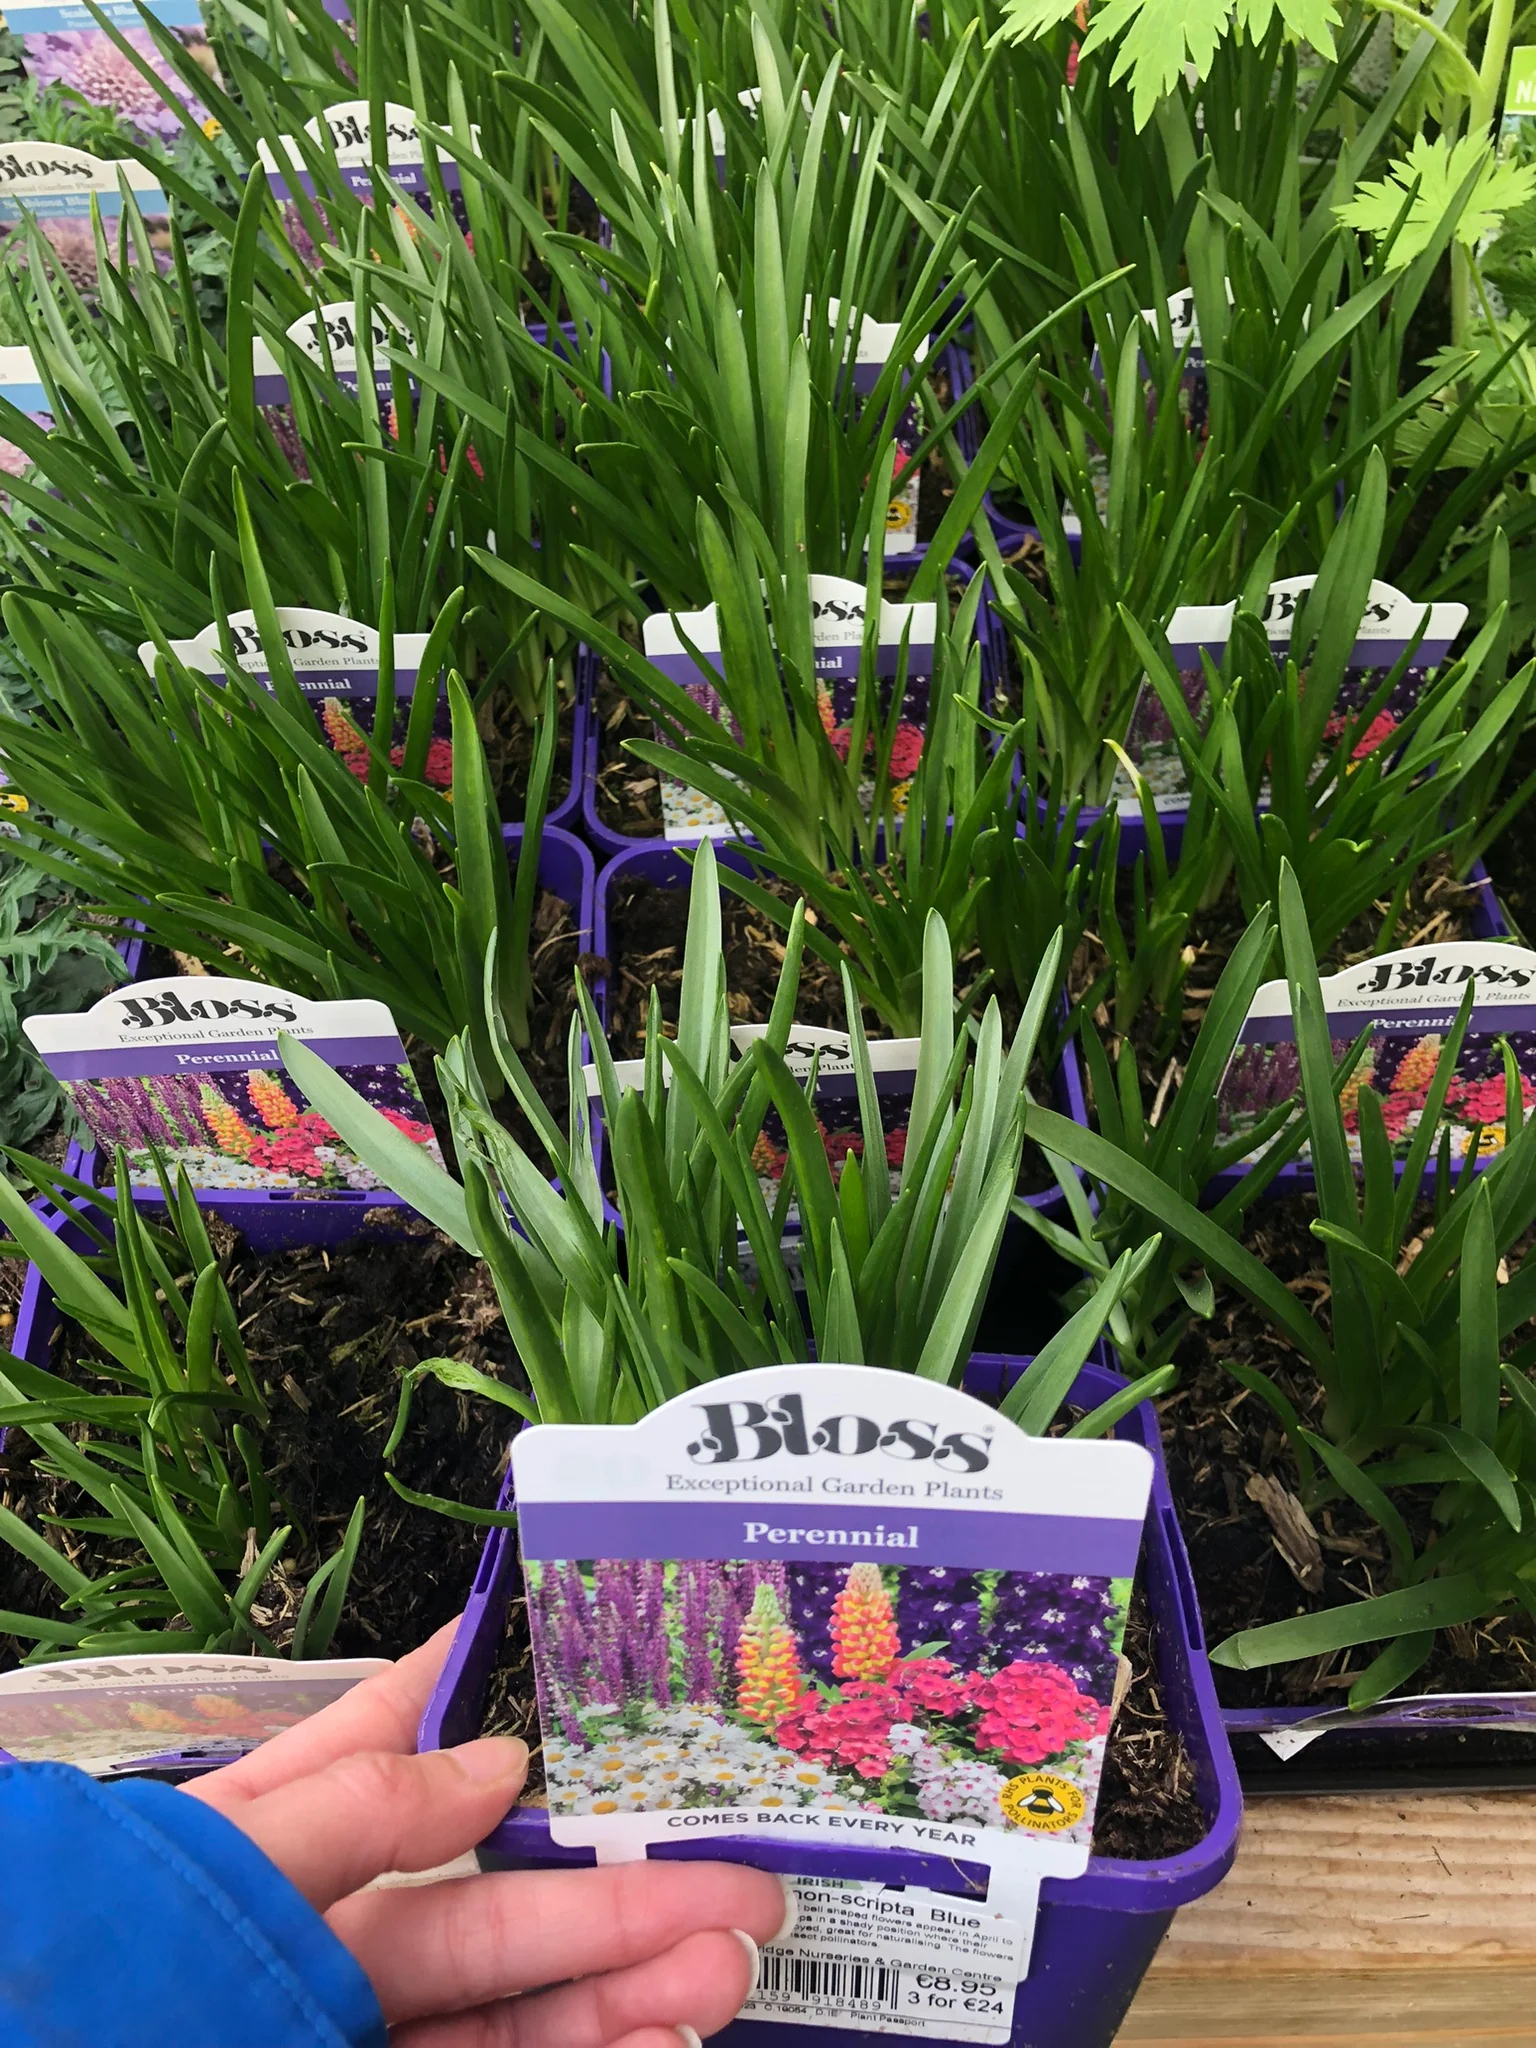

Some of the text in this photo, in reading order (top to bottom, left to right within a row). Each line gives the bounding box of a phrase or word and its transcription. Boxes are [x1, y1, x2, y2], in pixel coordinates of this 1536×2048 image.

[230, 624, 369, 655] Boss
[1357, 956, 1536, 995] Bloss
[113, 991, 298, 1029] Bloss
[1337, 991, 1531, 1008] Exceptional Gardn Plants
[118, 1030, 206, 1043] Exceptional
[208, 1028, 264, 1038] Garden
[174, 1049, 280, 1065] Perennial
[686, 1392, 993, 1474] Bloss
[666, 1474, 1004, 1501] Exceptional Garden Plants
[743, 1521, 920, 1549] Perennial
[1002, 1775, 1081, 1809] RHS PLANTS FOR
[667, 1812, 976, 1847] COMES BACK EVERY YEAR
[1004, 1804, 1078, 1829] POLLINATORS
[797, 1877, 844, 1889] IRISH
[803, 1904, 1013, 1945] bell shaped flowers appear in April to
[816, 1915, 826, 1923] in
[840, 1918, 873, 1930] shady
[877, 1924, 921, 1937] position
[924, 1932, 959, 1943] where
[962, 1938, 988, 1948] their
[931, 1908, 981, 1929] Blue
[827, 1926, 855, 1937] great
[859, 1930, 873, 1938] for
[949, 1943, 969, 1954] The
[973, 1948, 1014, 1961] flowers
[800, 1948, 870, 1964] Nurseries
[874, 1956, 885, 1965] &
[890, 1959, 947, 1974] Garden
[952, 1967, 1002, 1982] Centre
[916, 1973, 996, 1997] €8.95
[812, 1994, 881, 2011] 918489
[907, 1990, 1004, 2014] 3 for €24
[850, 2011, 876, 2021] Plant
[880, 2014, 926, 2027] Passport
